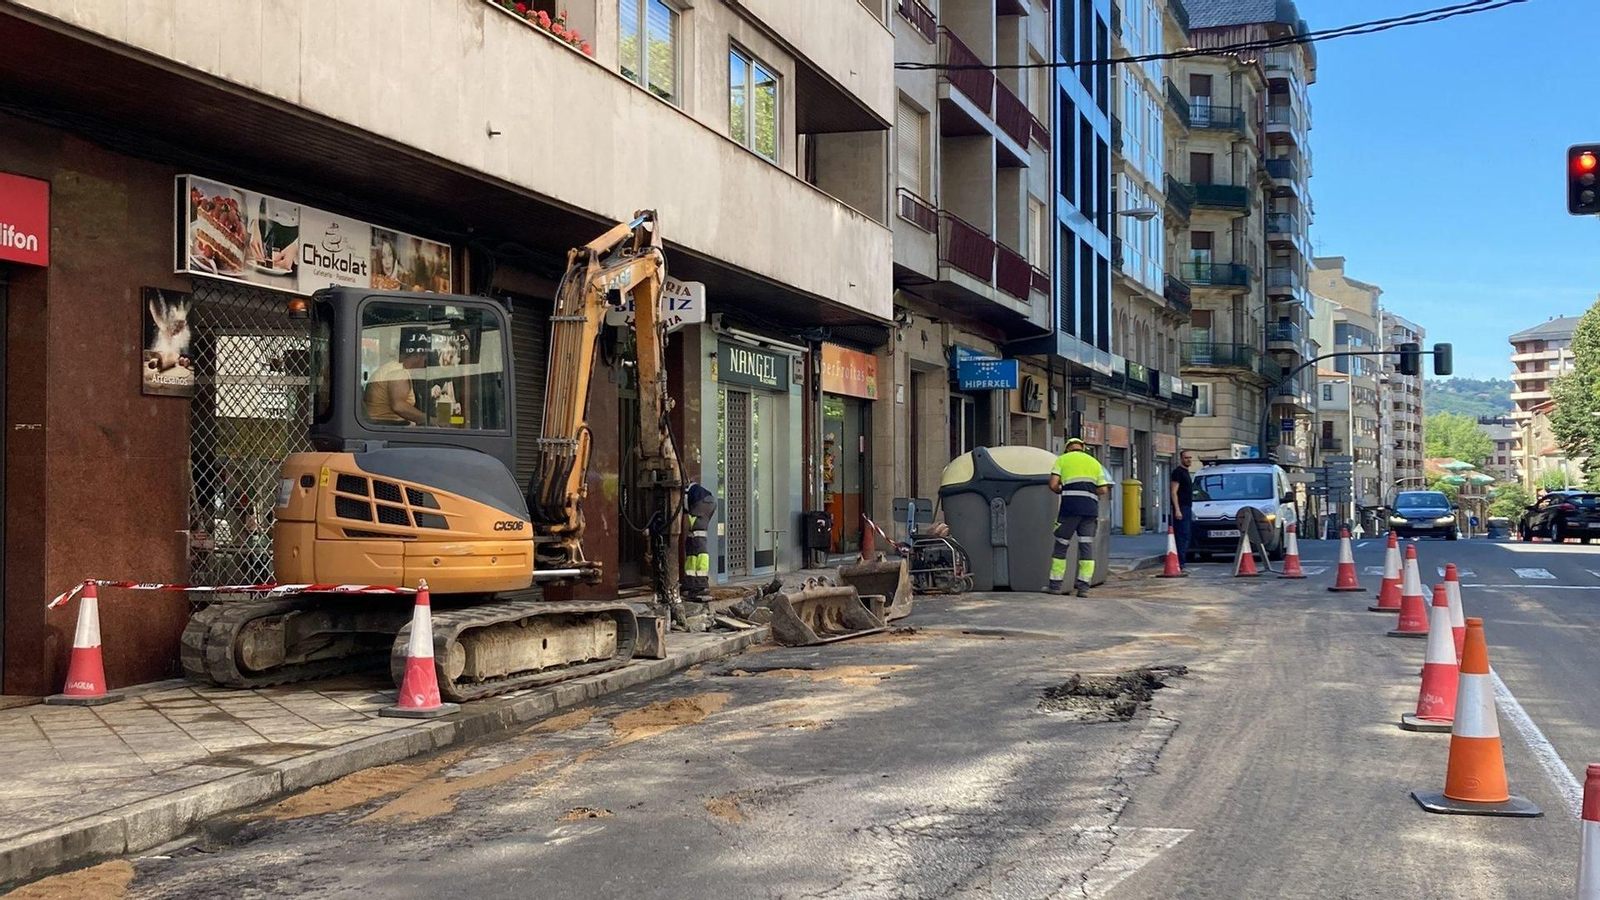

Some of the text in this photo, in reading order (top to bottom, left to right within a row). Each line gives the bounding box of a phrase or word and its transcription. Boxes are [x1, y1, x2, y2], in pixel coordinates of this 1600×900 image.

[303, 243, 367, 276] Chokolat
[729, 347, 777, 382] NANGEL
[151, 372, 188, 386] Artesanos
[965, 379, 1010, 388] HIPERXEL
[493, 520, 525, 531] CX50B
